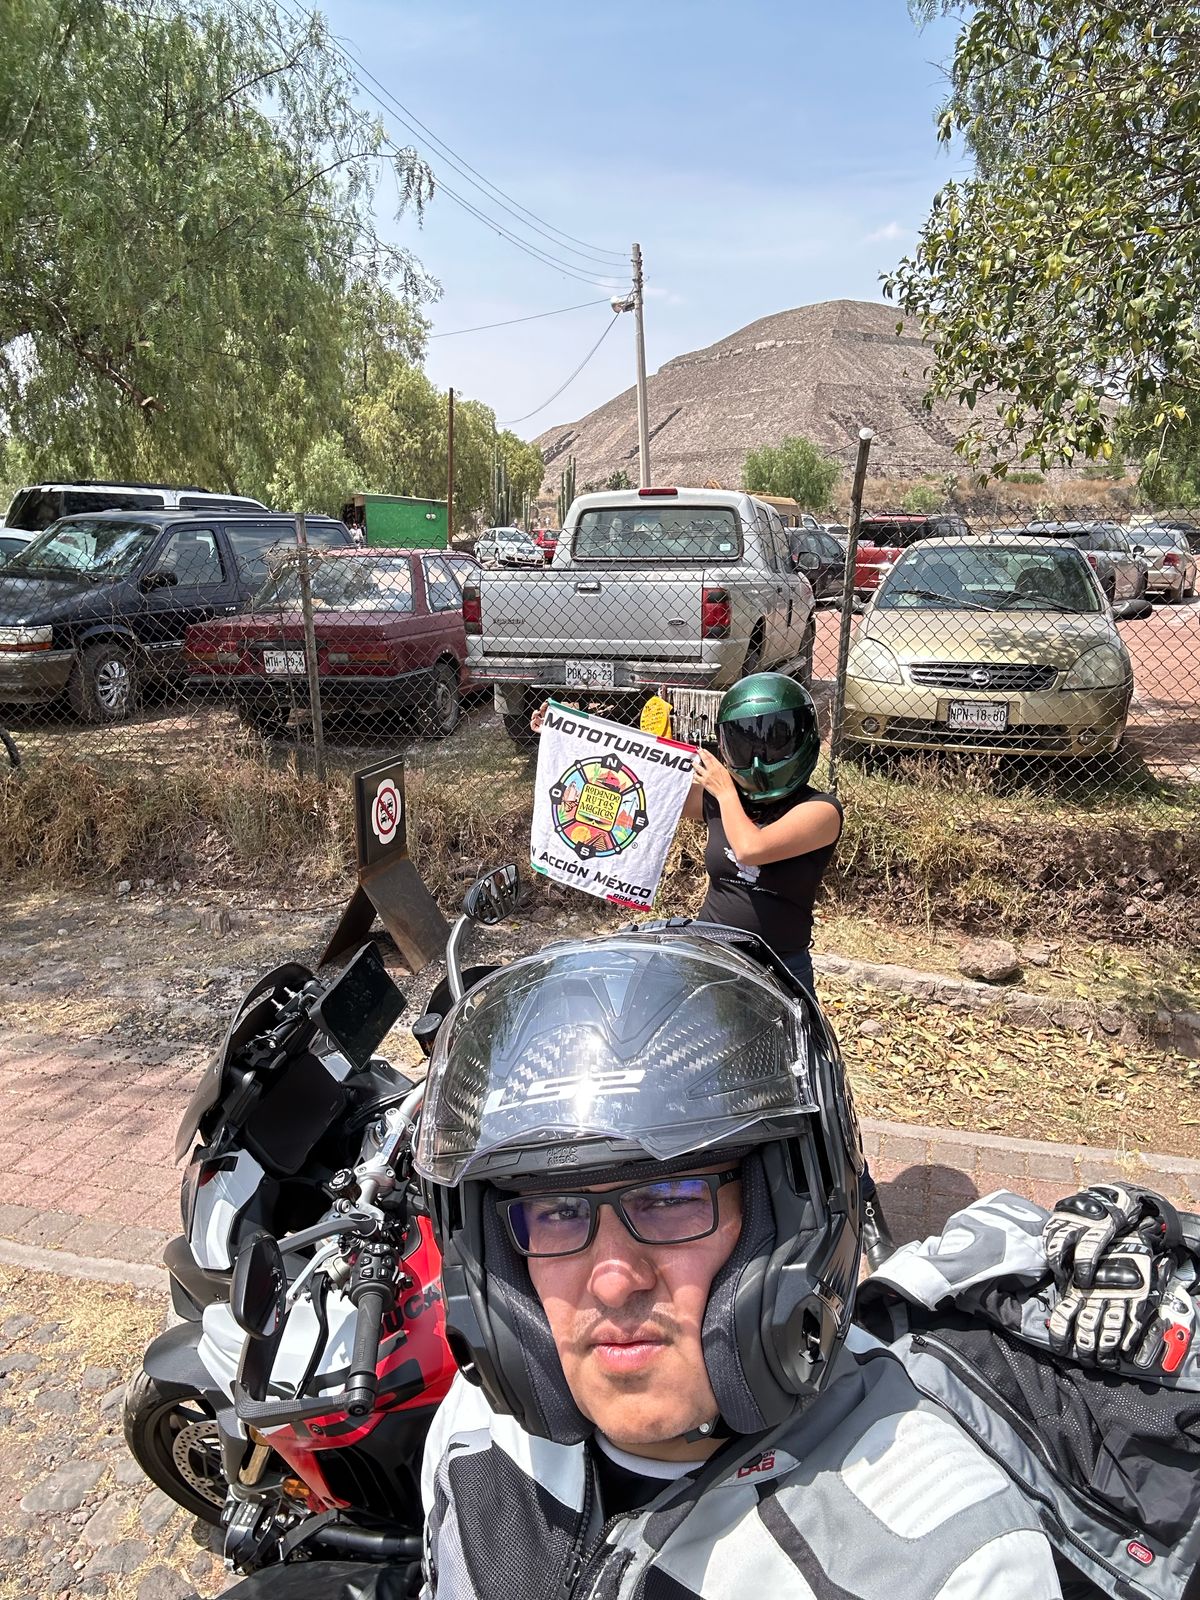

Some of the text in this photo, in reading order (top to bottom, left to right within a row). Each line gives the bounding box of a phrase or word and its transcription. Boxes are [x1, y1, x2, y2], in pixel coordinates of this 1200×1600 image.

[544, 712, 694, 773] MOTOTURISMO
[606, 757, 618, 768] N
[635, 817, 646, 827] E
[580, 846, 590, 857] S
[538, 851, 590, 879] ACCIÓN
[593, 871, 652, 899] MÉXICO
[482, 1069, 646, 1115] LS2
